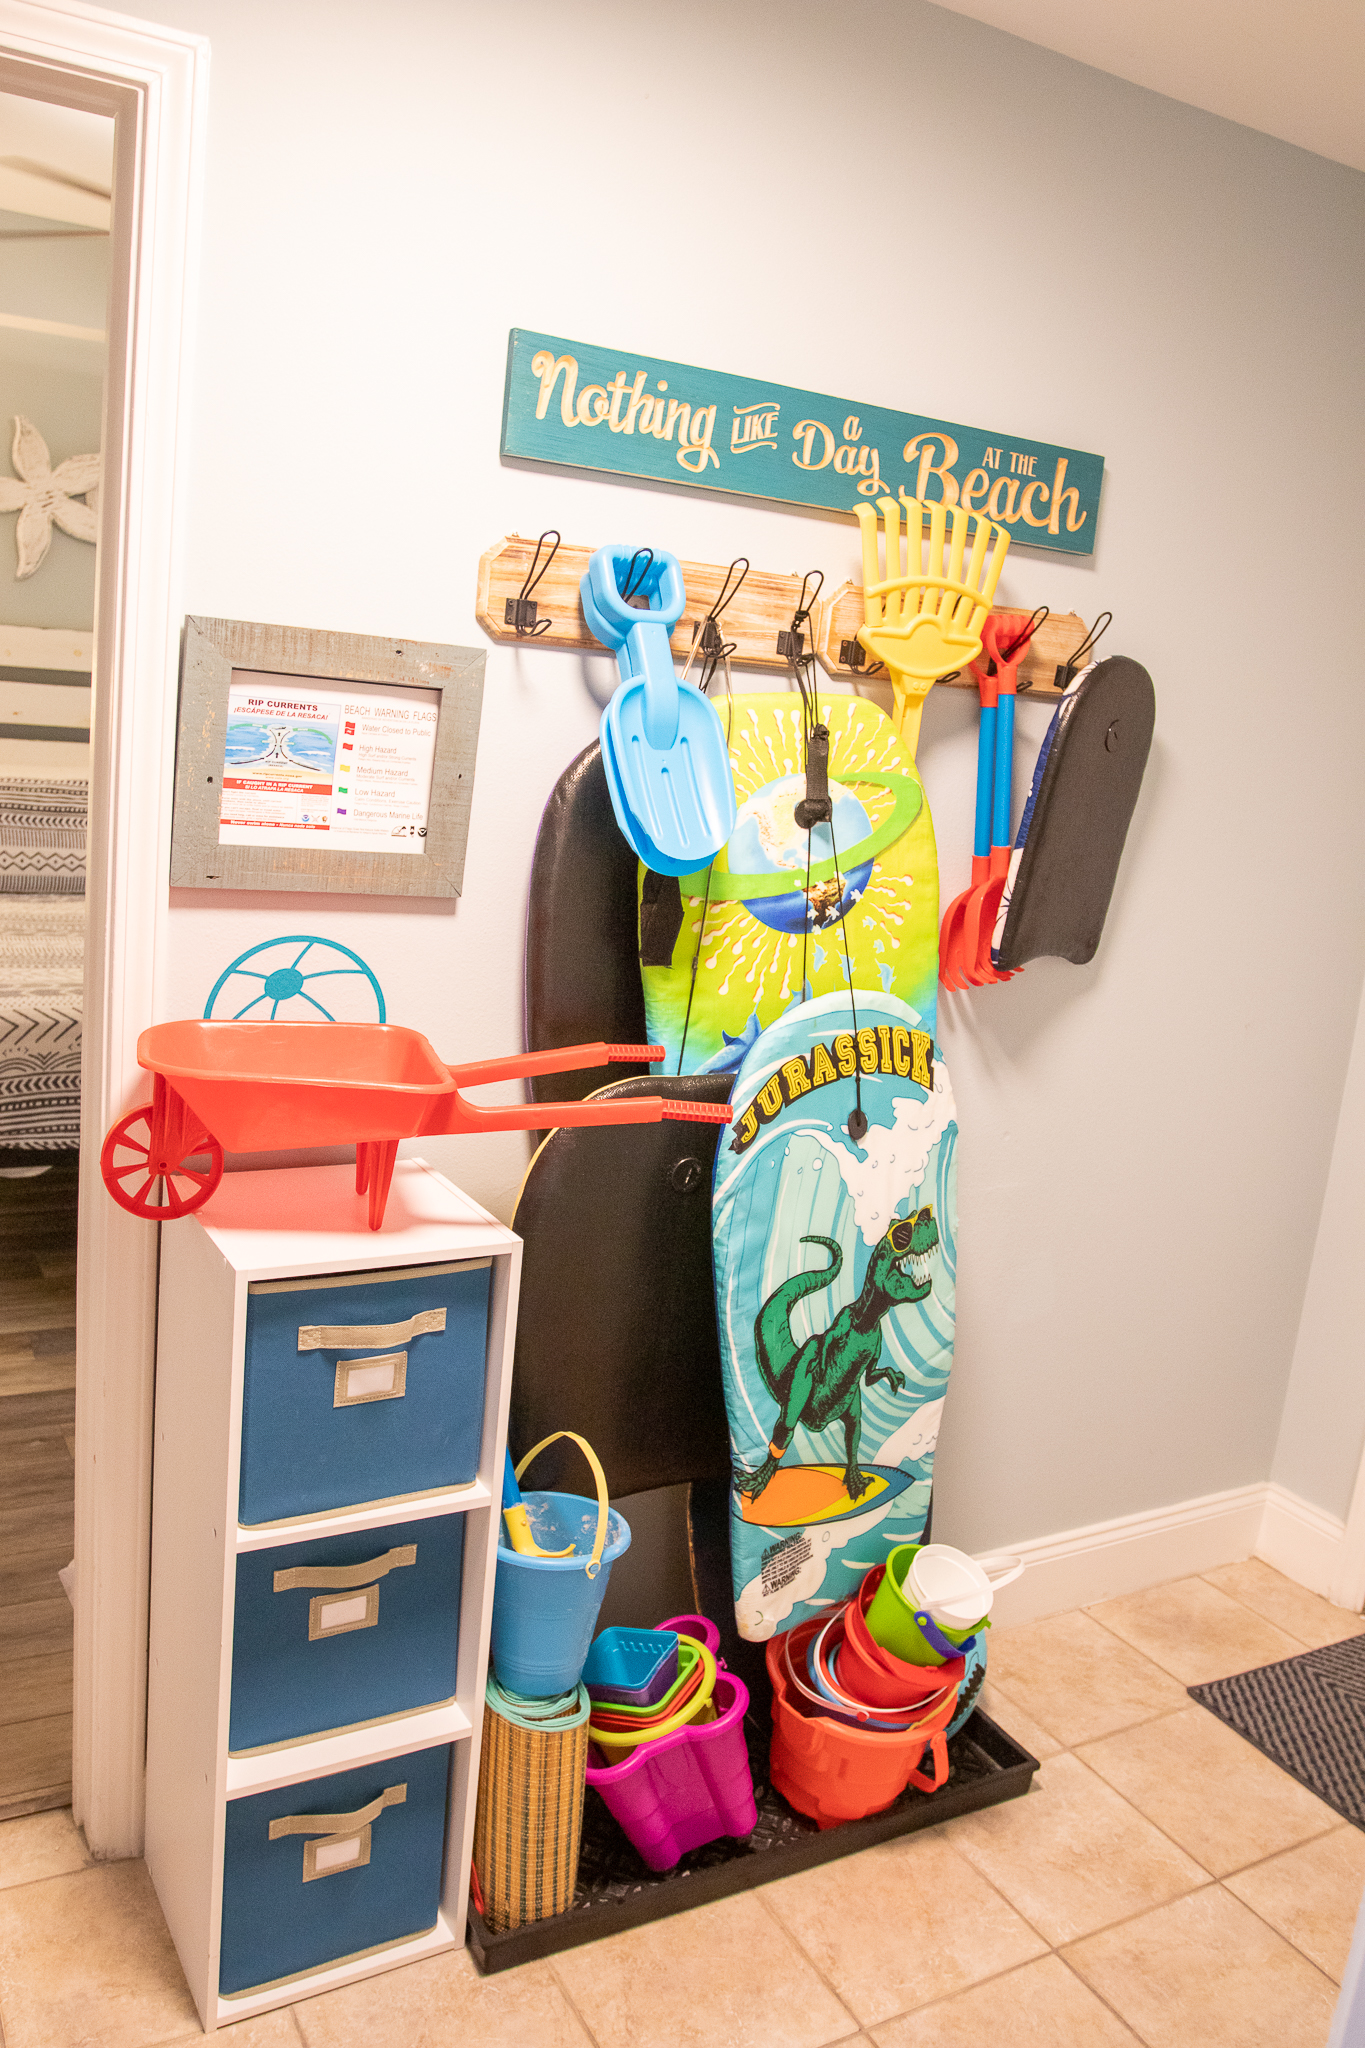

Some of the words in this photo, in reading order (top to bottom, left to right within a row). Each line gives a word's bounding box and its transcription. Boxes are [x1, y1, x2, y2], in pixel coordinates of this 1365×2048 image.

[531, 350, 720, 473] Nothing
[731, 411, 779, 446] LIKE
[843, 415, 863, 442] a
[791, 419, 890, 496] Day
[982, 447, 1003, 469] AT
[1009, 452, 1038, 477] THE
[898, 432, 1087, 535] Beach
[248, 698, 264, 706] RIP
[266, 700, 318, 711] CURRENTS
[344, 704, 371, 716] BEACH
[374, 707, 410, 719] WARNING
[413, 710, 437, 722] FLAGS
[297, 712, 328, 720] RESACA!
[362, 724, 381, 732] Water
[382, 725, 403, 735] Closed
[412, 728, 431, 737] Public
[359, 744, 374, 754] High
[374, 745, 397, 754] Hazard
[356, 766, 383, 775] Medium
[384, 768, 409, 777] Hazard
[354, 788, 369, 796] Low
[370, 789, 396, 798] Hazard
[353, 809, 387, 819] Dangerous
[389, 811, 411, 819] Marine
[411, 812, 423, 820] Life
[734, 1025, 934, 1149] JURASSICK
